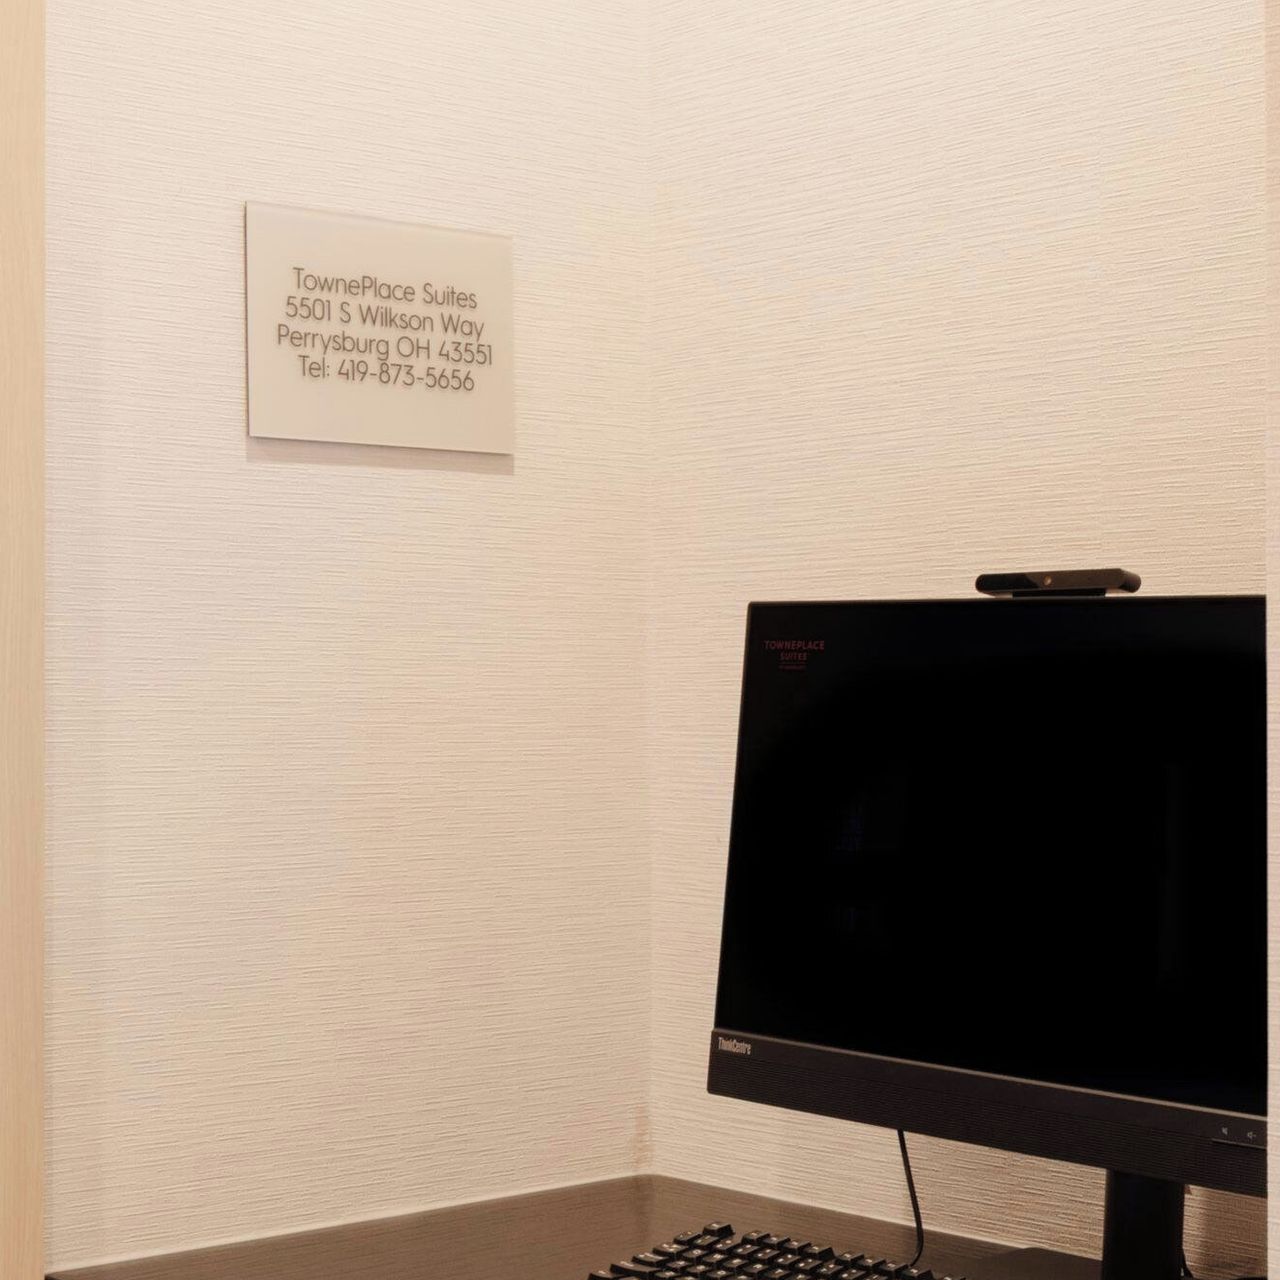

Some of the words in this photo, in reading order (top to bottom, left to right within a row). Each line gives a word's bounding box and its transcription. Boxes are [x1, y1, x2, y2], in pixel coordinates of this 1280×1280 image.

[293, 267, 415, 303] TownePlace
[423, 283, 477, 309] Suites
[285, 296, 331, 321] 5501
[340, 302, 351, 323] S
[359, 304, 433, 332] Wilkson
[441, 313, 484, 342] Way
[277, 323, 389, 361] Perrysburg
[396, 336, 430, 359] OH
[438, 340, 492, 365] 43551
[298, 355, 330, 378] Tel:
[338, 360, 475, 391] 419-873-5656
